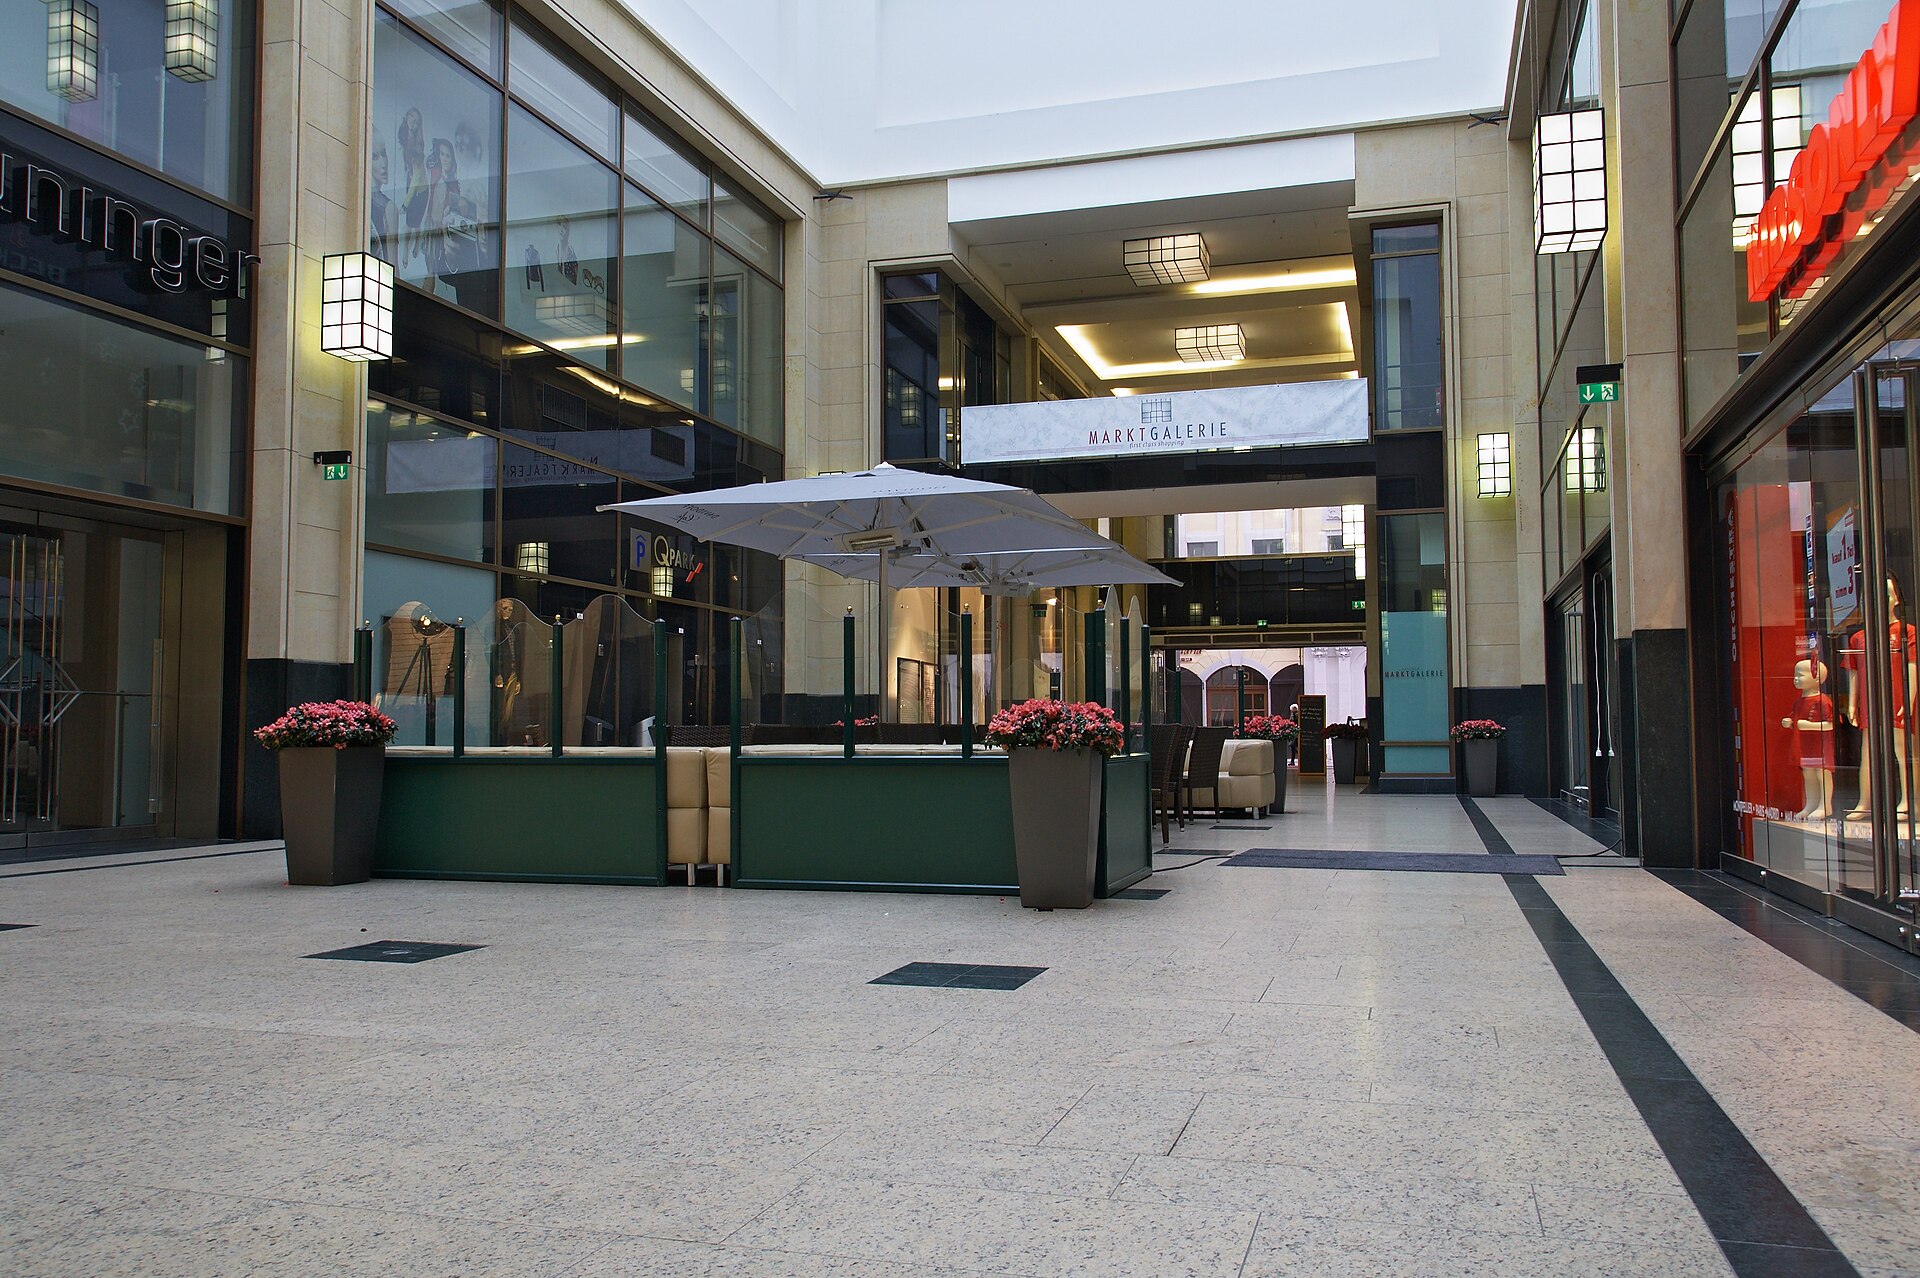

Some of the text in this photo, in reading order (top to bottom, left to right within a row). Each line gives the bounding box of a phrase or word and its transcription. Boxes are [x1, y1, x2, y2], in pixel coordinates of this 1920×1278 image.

[1088, 422, 1227, 445] MARKTGALERIE
[635, 541, 646, 567] P
[1847, 565, 1854, 594] 3
[1384, 670, 1443, 678] MARKTGALERIE
